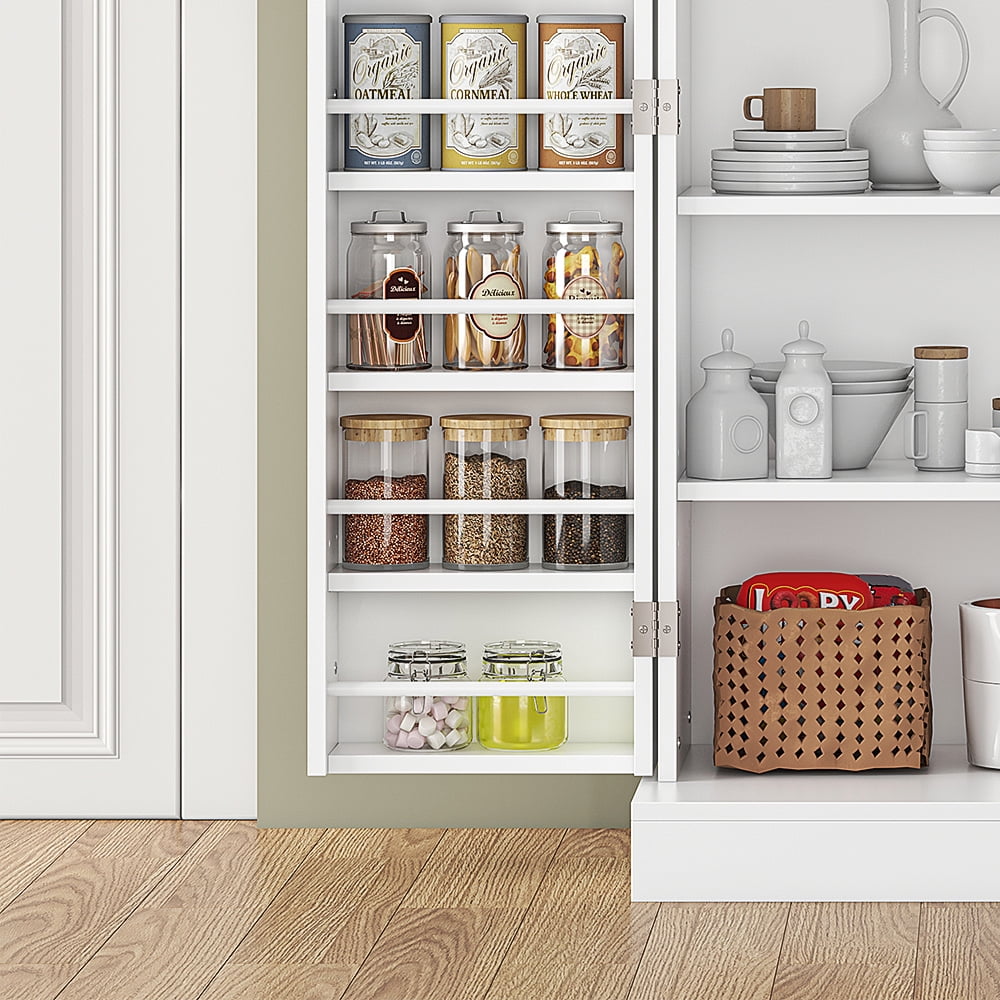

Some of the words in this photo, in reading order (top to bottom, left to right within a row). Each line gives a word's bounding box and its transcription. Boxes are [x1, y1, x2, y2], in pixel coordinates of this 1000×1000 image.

[353, 43, 412, 87] Organic
[450, 43, 508, 87] Organic
[547, 43, 607, 87] Organic
[354, 88, 413, 99] OATMEAL
[451, 88, 512, 99] CORNMEAL
[546, 90, 578, 99] WHOLE
[580, 90, 613, 99] WHEAT
